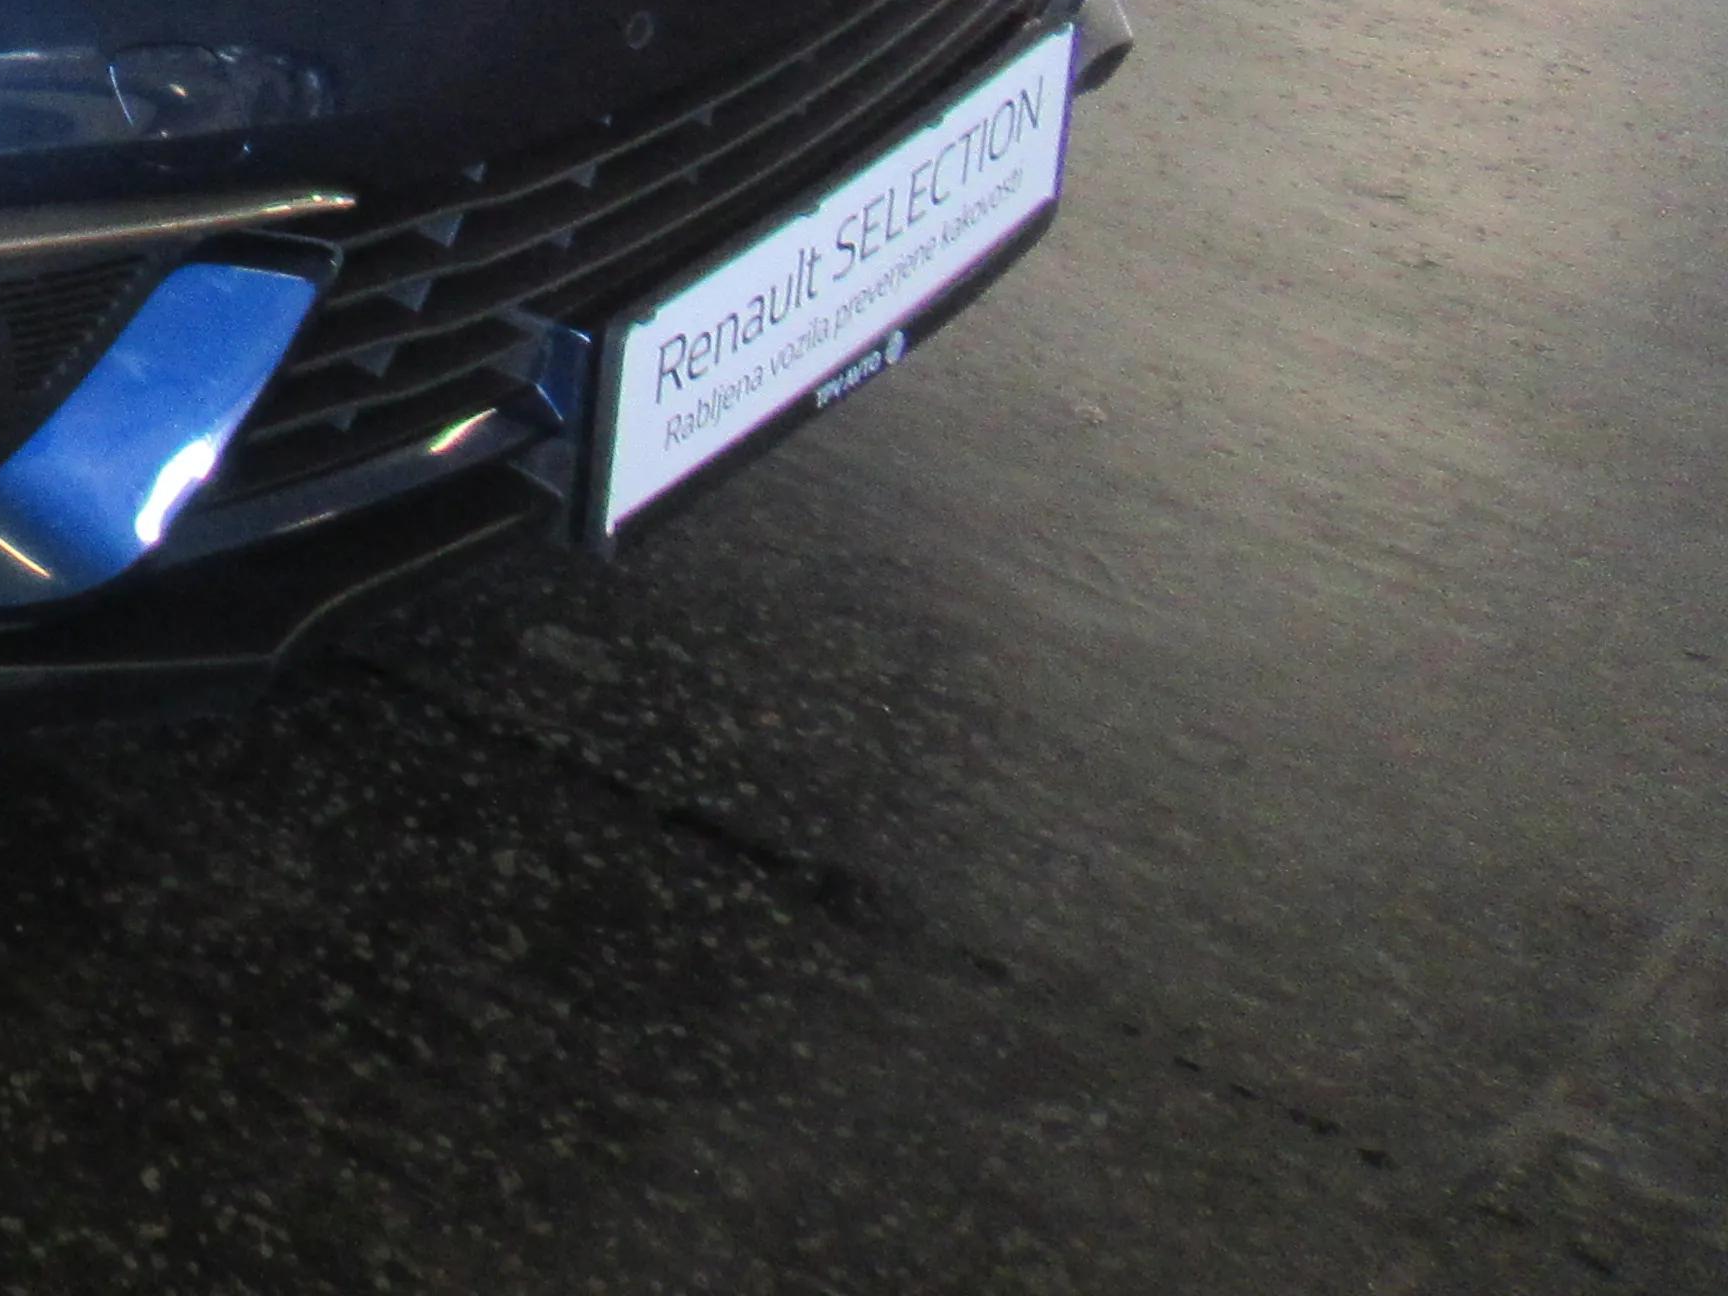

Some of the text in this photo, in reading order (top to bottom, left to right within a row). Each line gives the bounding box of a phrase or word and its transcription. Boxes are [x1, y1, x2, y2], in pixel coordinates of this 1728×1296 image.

[654, 74, 1044, 406] Renault SELECTION
[663, 363, 764, 452] Rabljena
[769, 315, 830, 376] vozila
